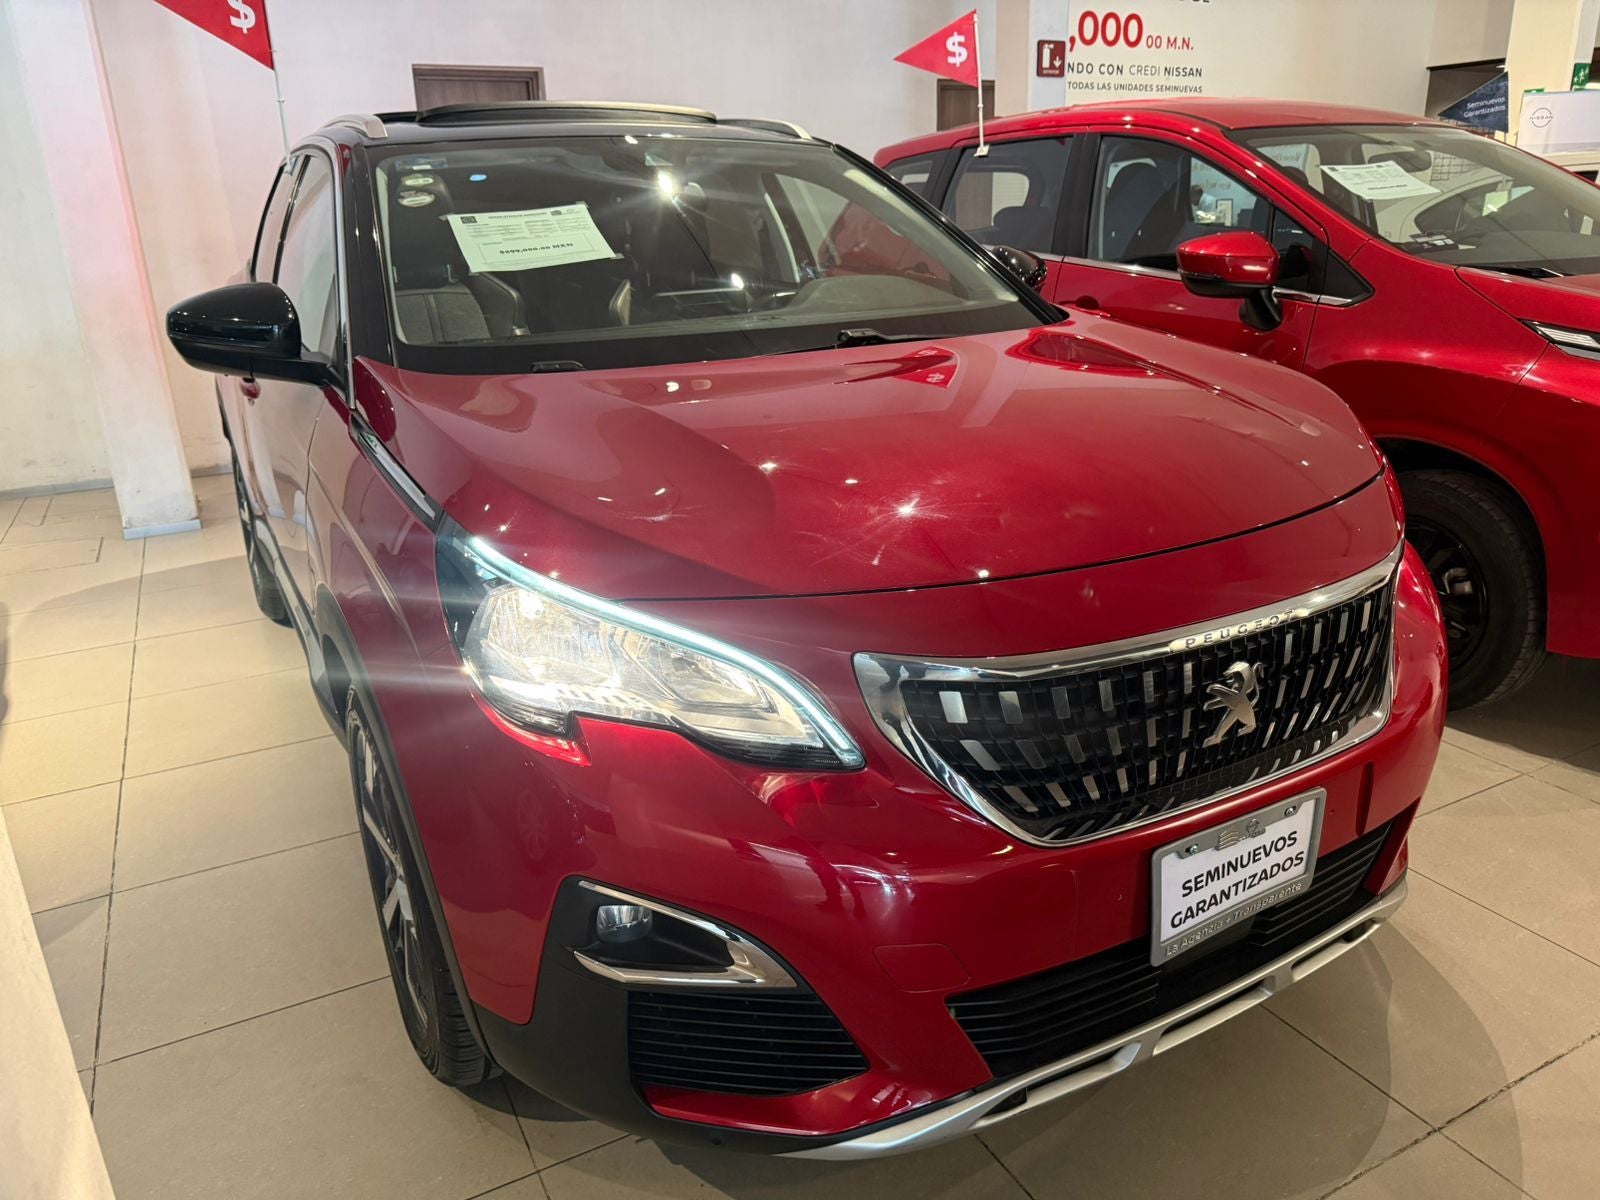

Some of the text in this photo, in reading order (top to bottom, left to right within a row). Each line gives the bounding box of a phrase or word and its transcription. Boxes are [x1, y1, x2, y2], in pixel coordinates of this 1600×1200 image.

[945, 31, 968, 68] $
[1145, 34, 1163, 50] 00
[1165, 36, 1195, 51] M.N.
[1067, 61, 1094, 76] NDO
[1098, 63, 1124, 76] CON
[1128, 64, 1161, 77] CREDI
[1163, 66, 1203, 79] NISSAN
[1067, 81, 1203, 94] TODAS LAS UNIDADES SEMINUEVAS
[1463, 105, 1506, 118] Garantizados
[1466, 96, 1506, 110] Seminuevos
[1184, 608, 1297, 650] PEUGEOT
[1181, 830, 1298, 898] SEMINUEVOS
[1170, 850, 1305, 929] GARANTIZADOS
[1232, 883, 1302, 920] Transparente
